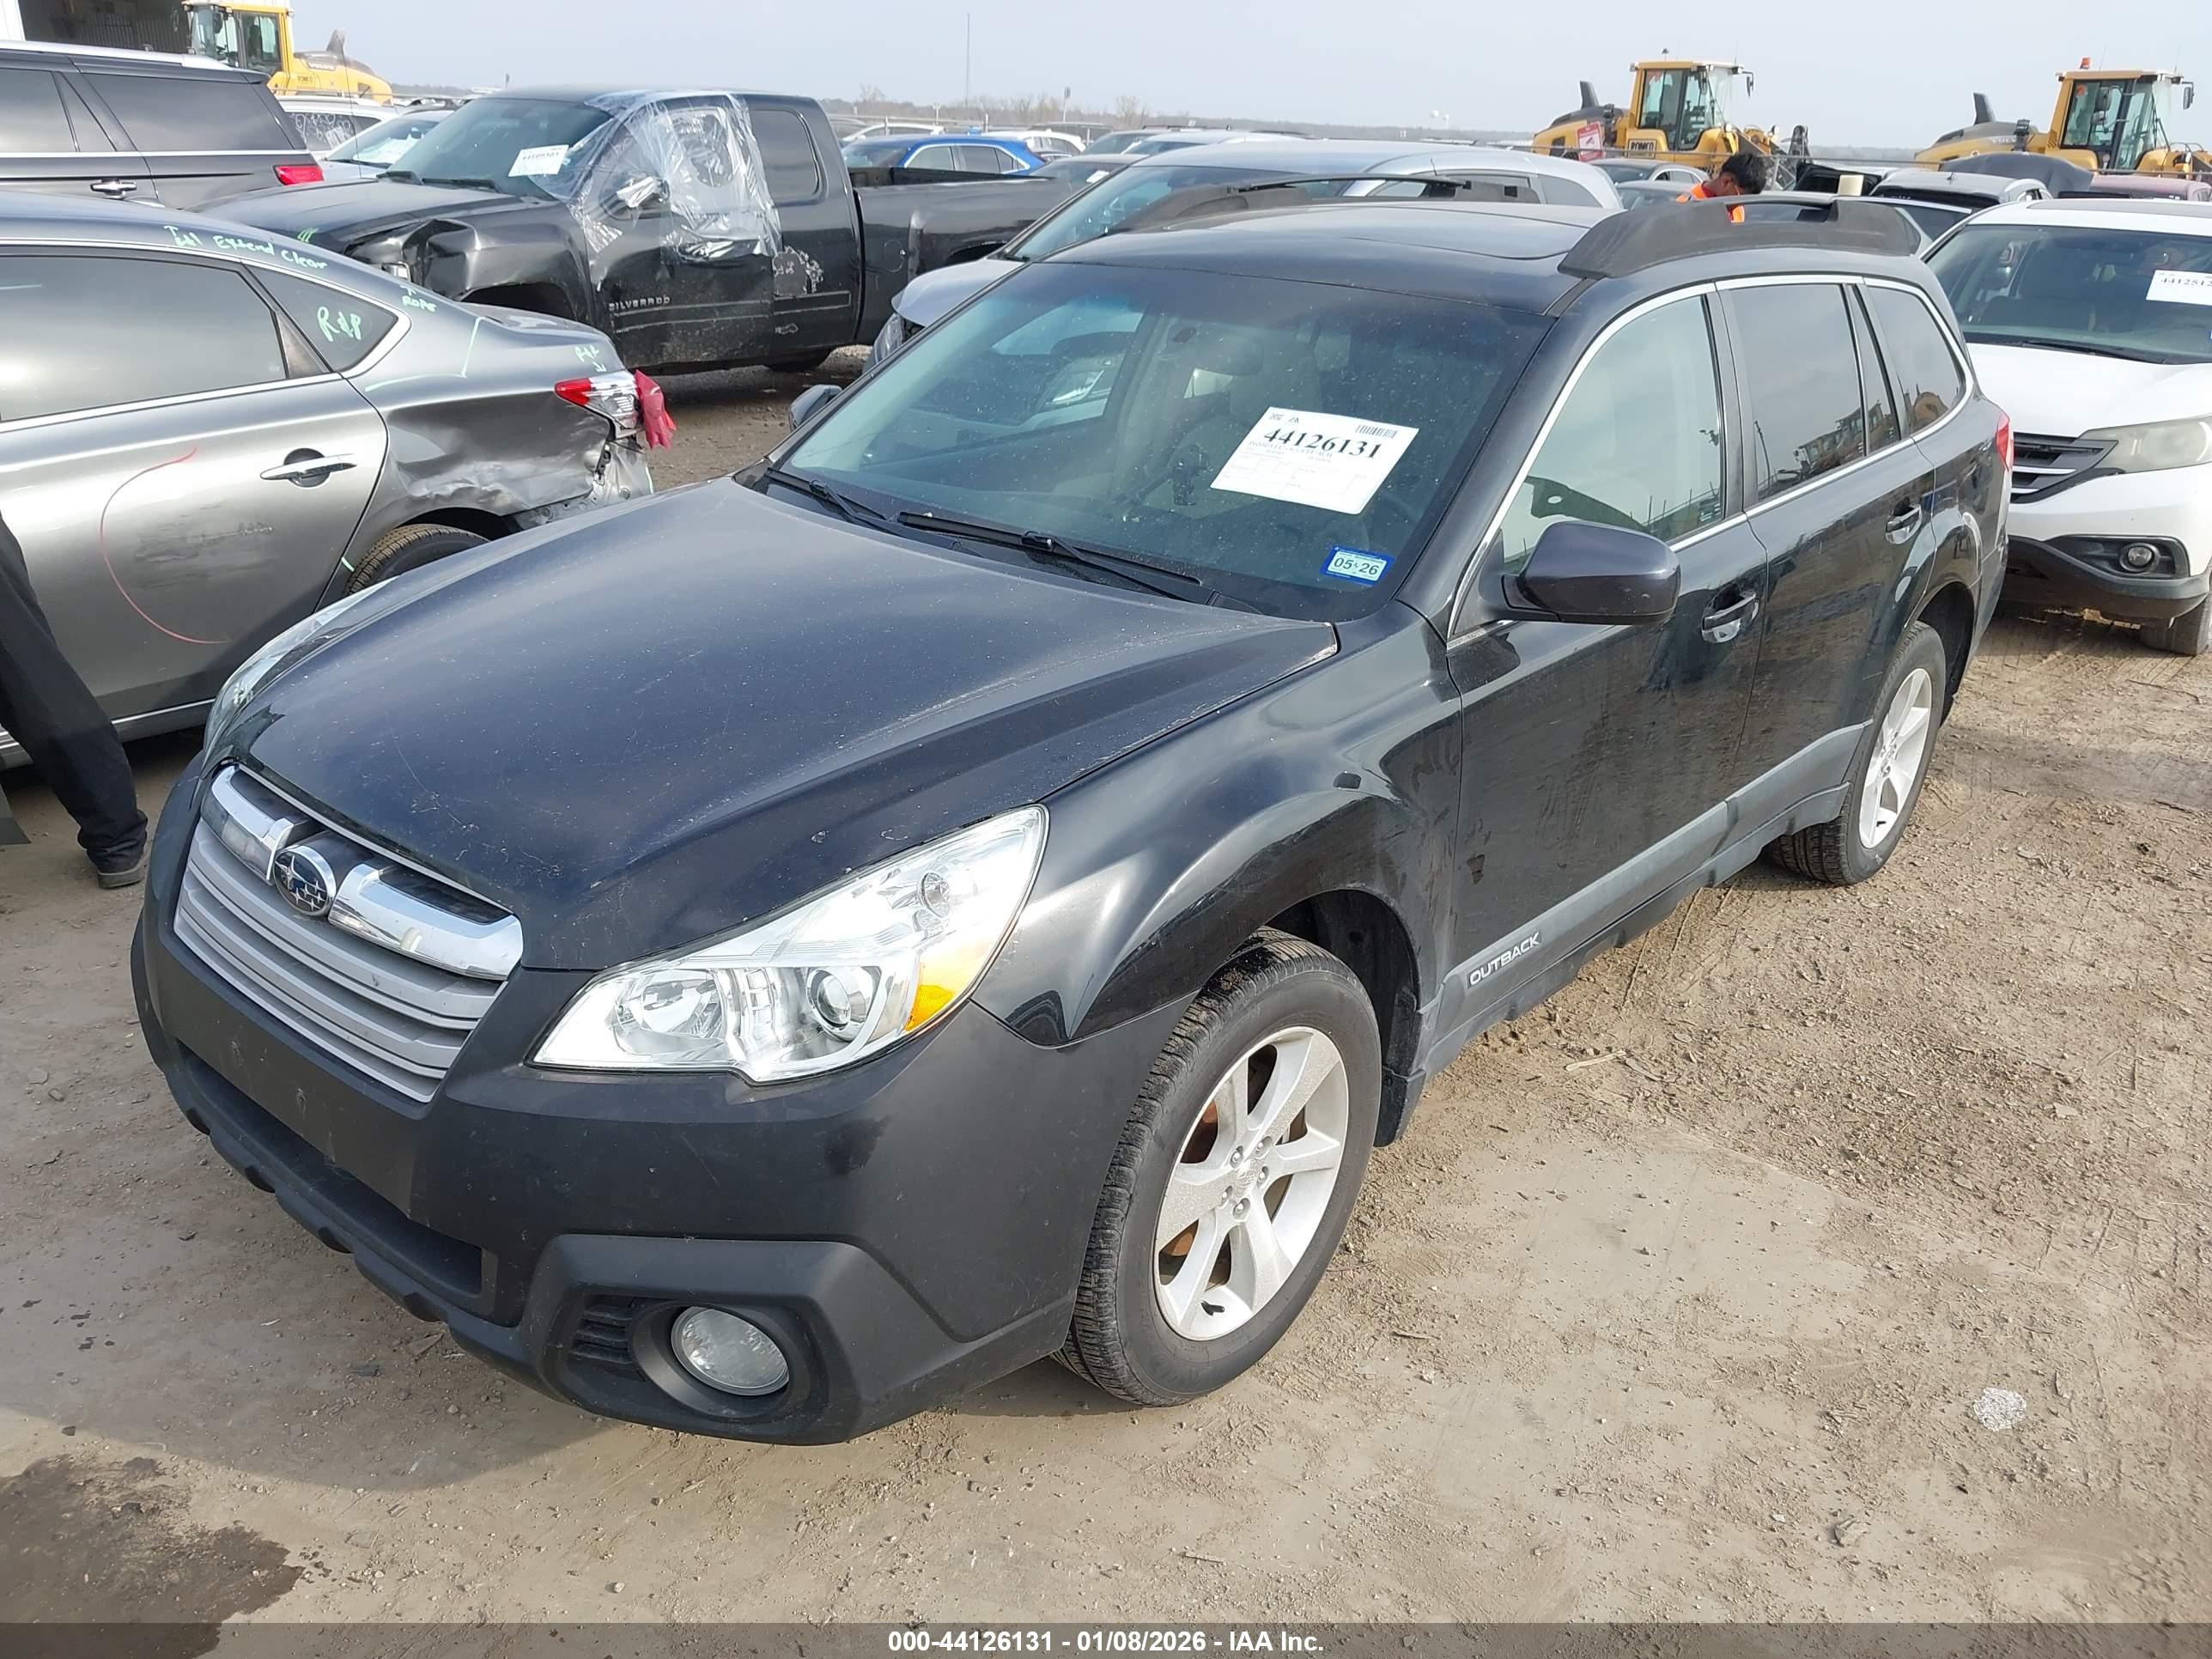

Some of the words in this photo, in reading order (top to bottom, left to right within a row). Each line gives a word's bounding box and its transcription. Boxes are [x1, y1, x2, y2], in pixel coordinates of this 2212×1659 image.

[609, 295, 671, 311] SILVERADO
[1264, 428, 1382, 459] 44126131
[1469, 932, 1540, 986] OUTBACK
